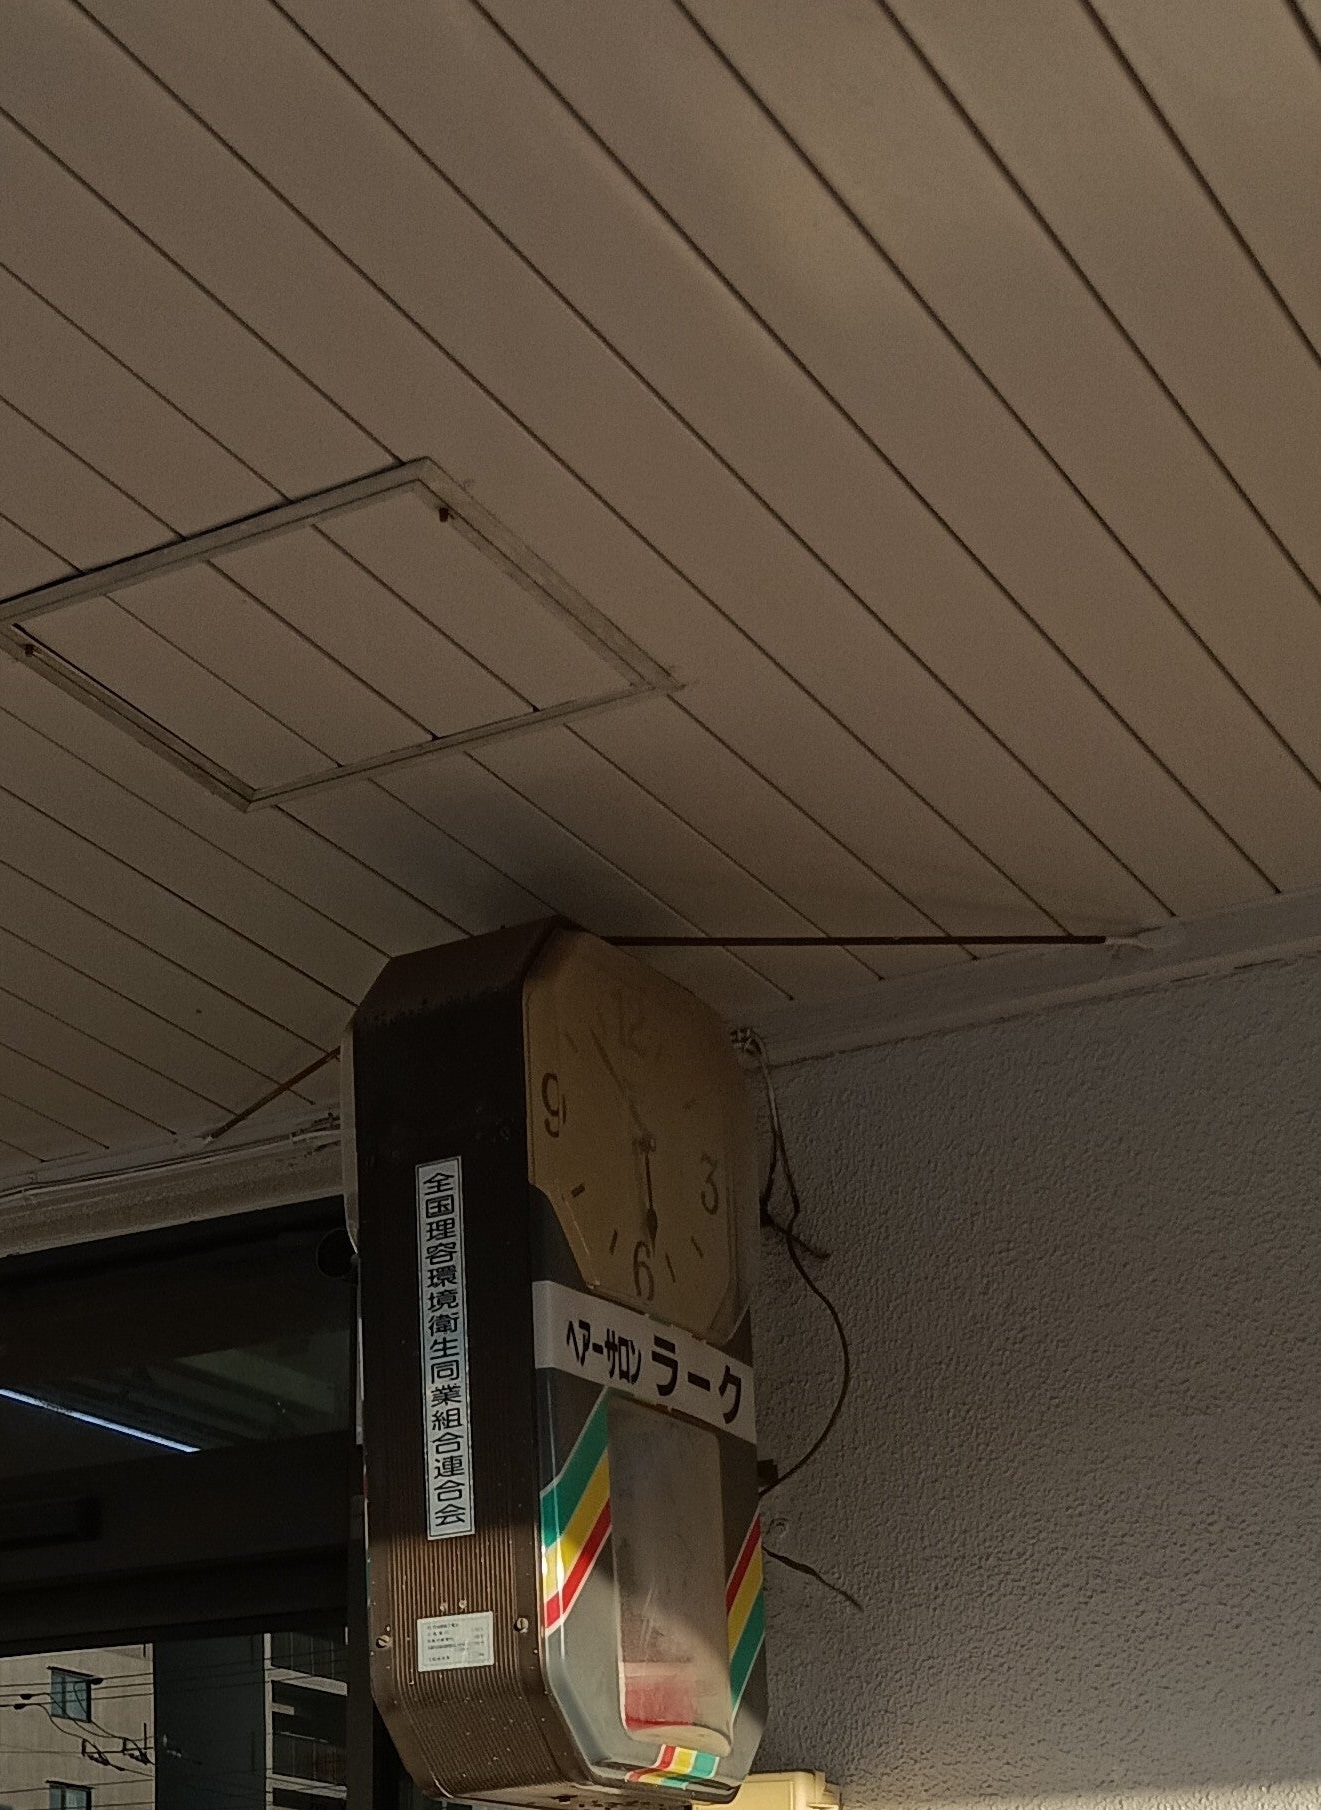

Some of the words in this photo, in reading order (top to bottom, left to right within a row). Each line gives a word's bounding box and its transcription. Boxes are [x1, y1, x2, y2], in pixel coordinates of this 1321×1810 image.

[423, 1172, 468, 1528] 全国理容環境衛生同業組合連合会
[650, 1335, 744, 1424] ラーク
